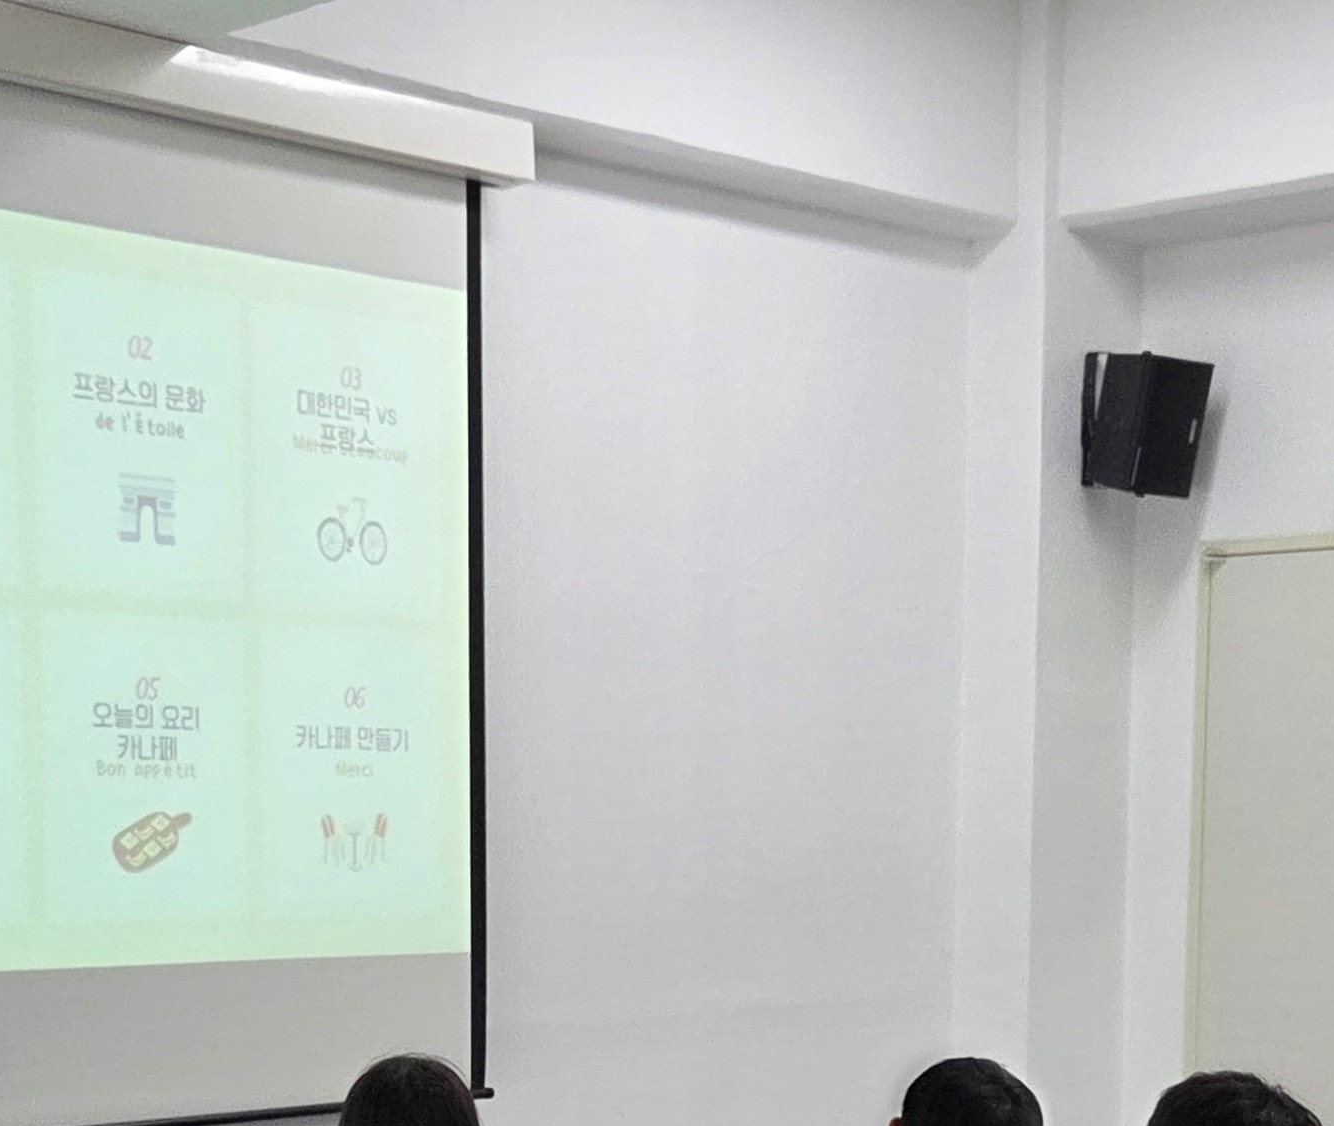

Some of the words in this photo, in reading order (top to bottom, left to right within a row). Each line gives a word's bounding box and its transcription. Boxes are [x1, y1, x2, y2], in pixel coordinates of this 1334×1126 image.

[127, 334, 154, 362] 02
[340, 366, 363, 390] 03
[73, 372, 158, 409] 프랑스의
[165, 384, 206, 414] 문화
[297, 389, 371, 424] 대한민국
[320, 423, 376, 453] 프랑스
[136, 677, 161, 701] 05
[344, 686, 368, 709] 06
[92, 702, 154, 729] 오늘의
[162, 705, 200, 731] 요리
[117, 734, 178, 761] 카나페
[295, 725, 352, 751] 카나페
[358, 727, 409, 752] 만들기
[96, 760, 126, 777] Bon
